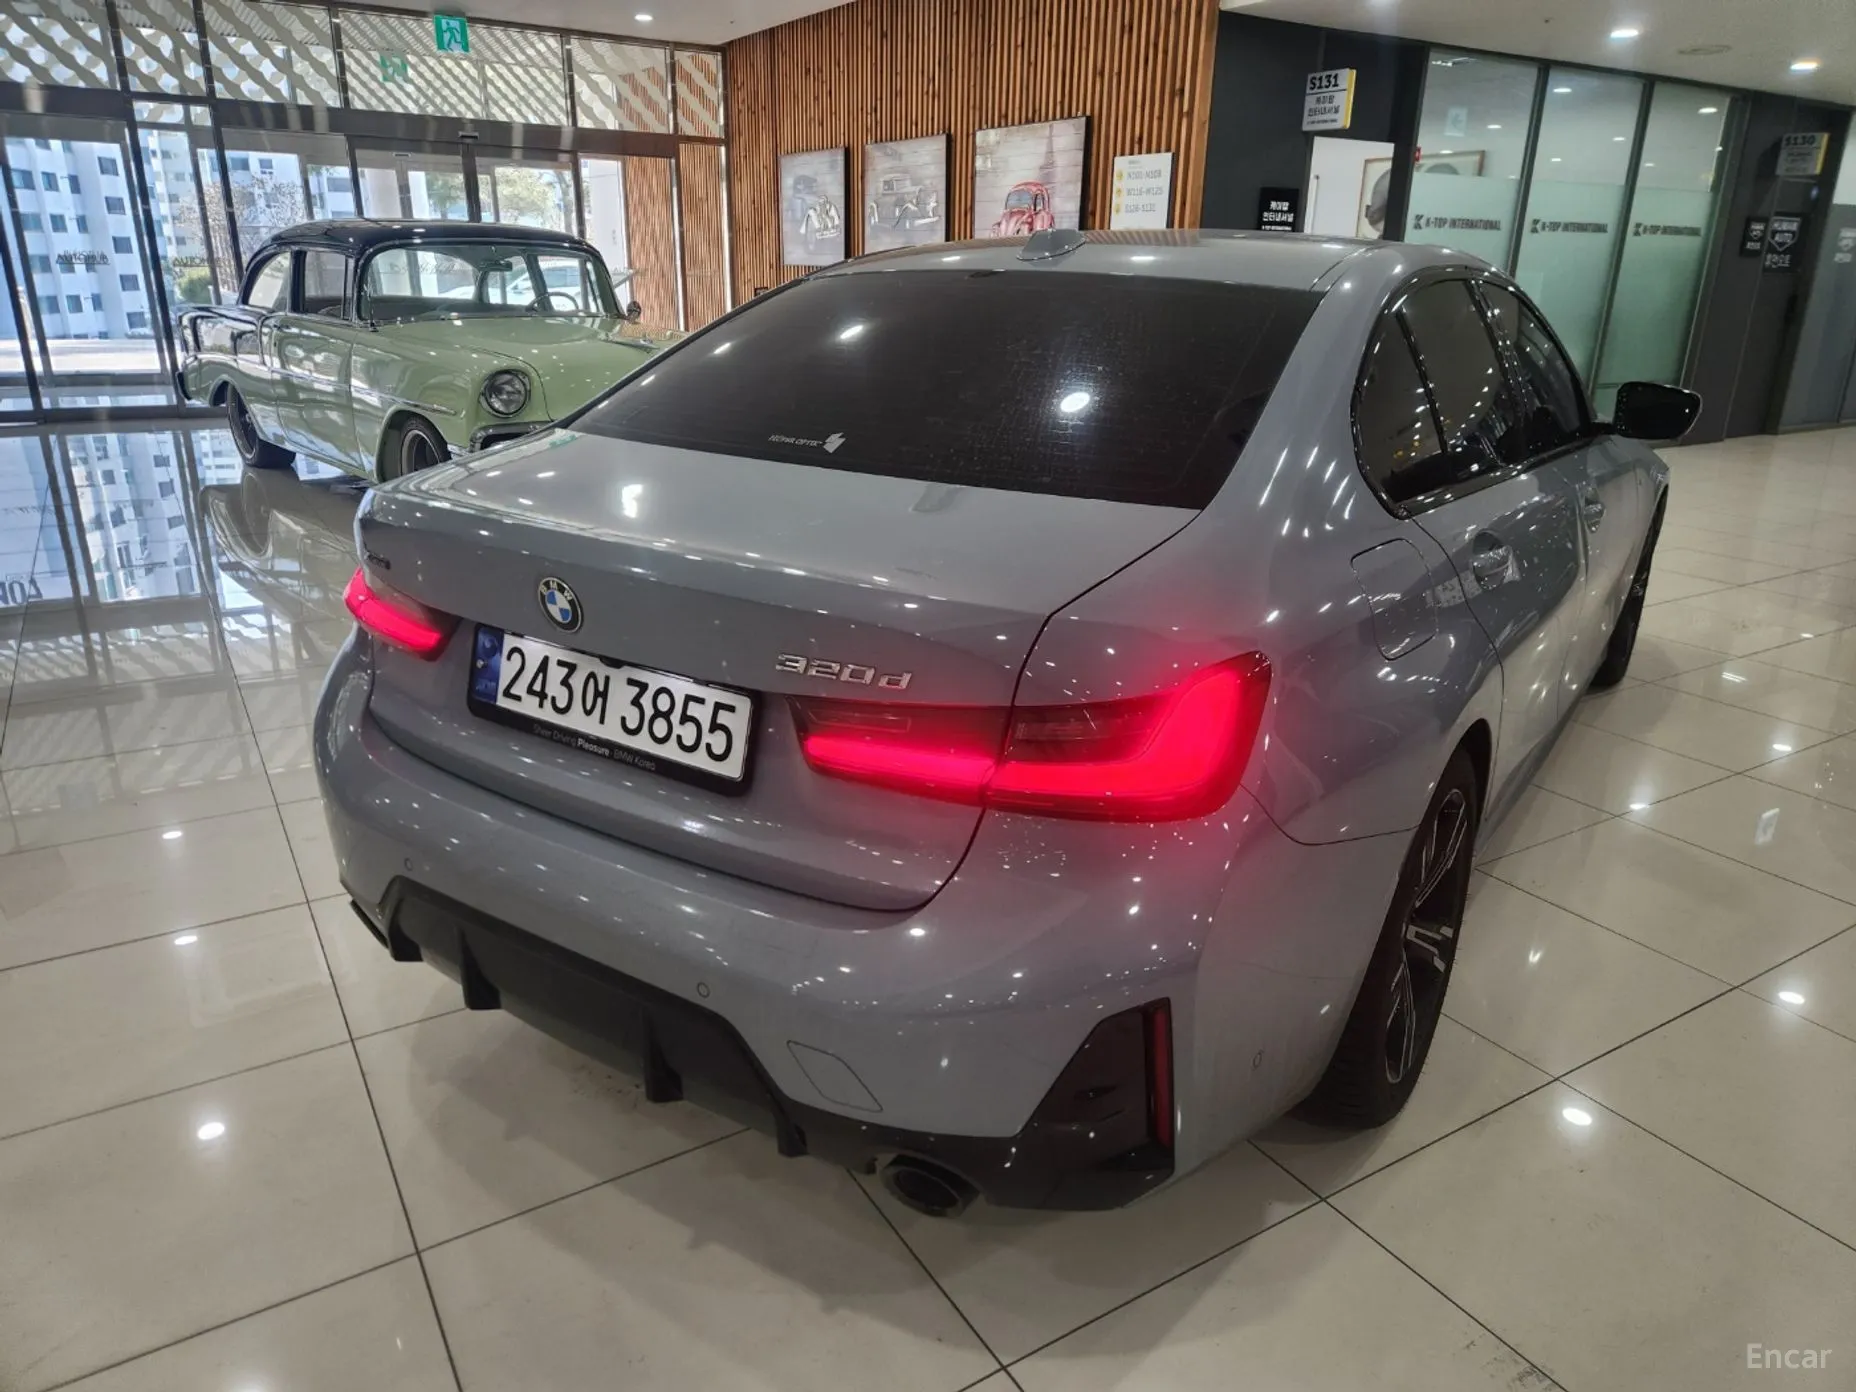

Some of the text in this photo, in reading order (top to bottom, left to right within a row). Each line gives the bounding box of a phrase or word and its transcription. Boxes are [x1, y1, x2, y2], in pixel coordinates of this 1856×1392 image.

[1309, 73, 1339, 90] S131
[776, 653, 912, 690] 320d
[502, 646, 736, 762] 243어 3855
[577, 738, 610, 757] Pleasure
[613, 748, 633, 764] BMW
